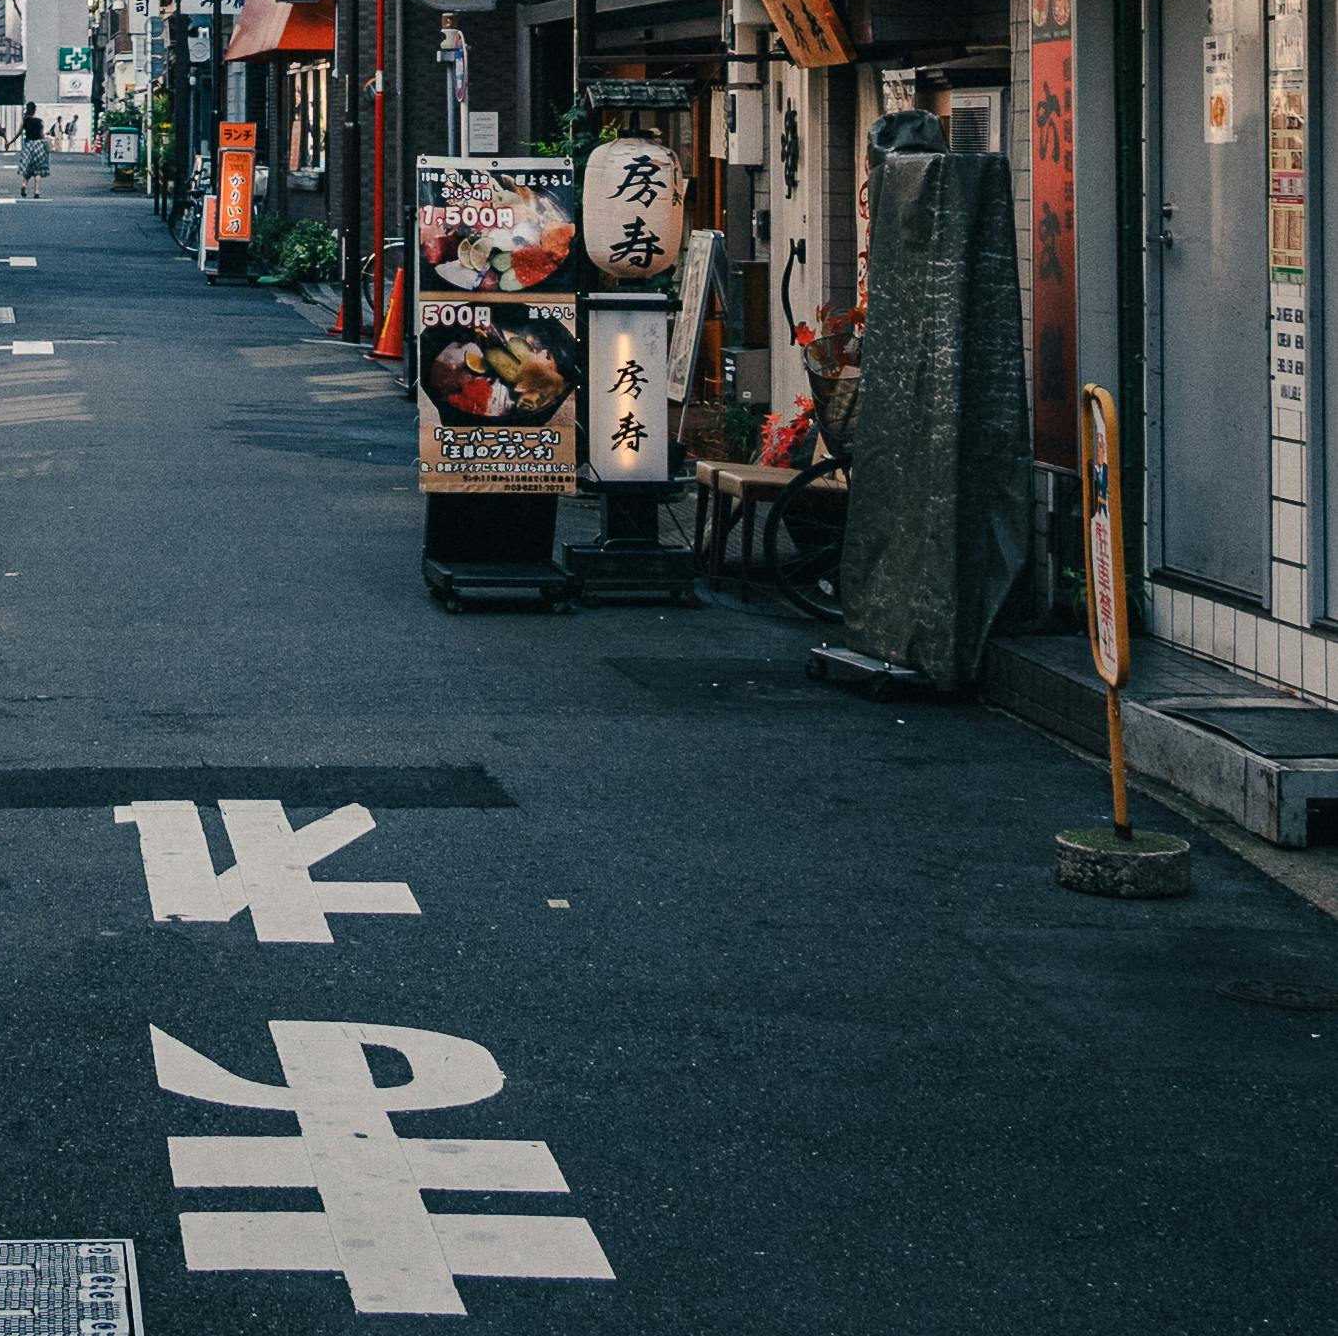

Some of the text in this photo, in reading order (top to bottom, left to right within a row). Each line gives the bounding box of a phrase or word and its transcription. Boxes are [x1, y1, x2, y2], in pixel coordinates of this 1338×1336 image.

[223, 127, 254, 143] ランチ
[423, 204, 515, 229] 1,500円
[605, 154, 668, 271] 房寿
[422, 304, 492, 328] 500円
[606, 360, 650, 453] 房寿
